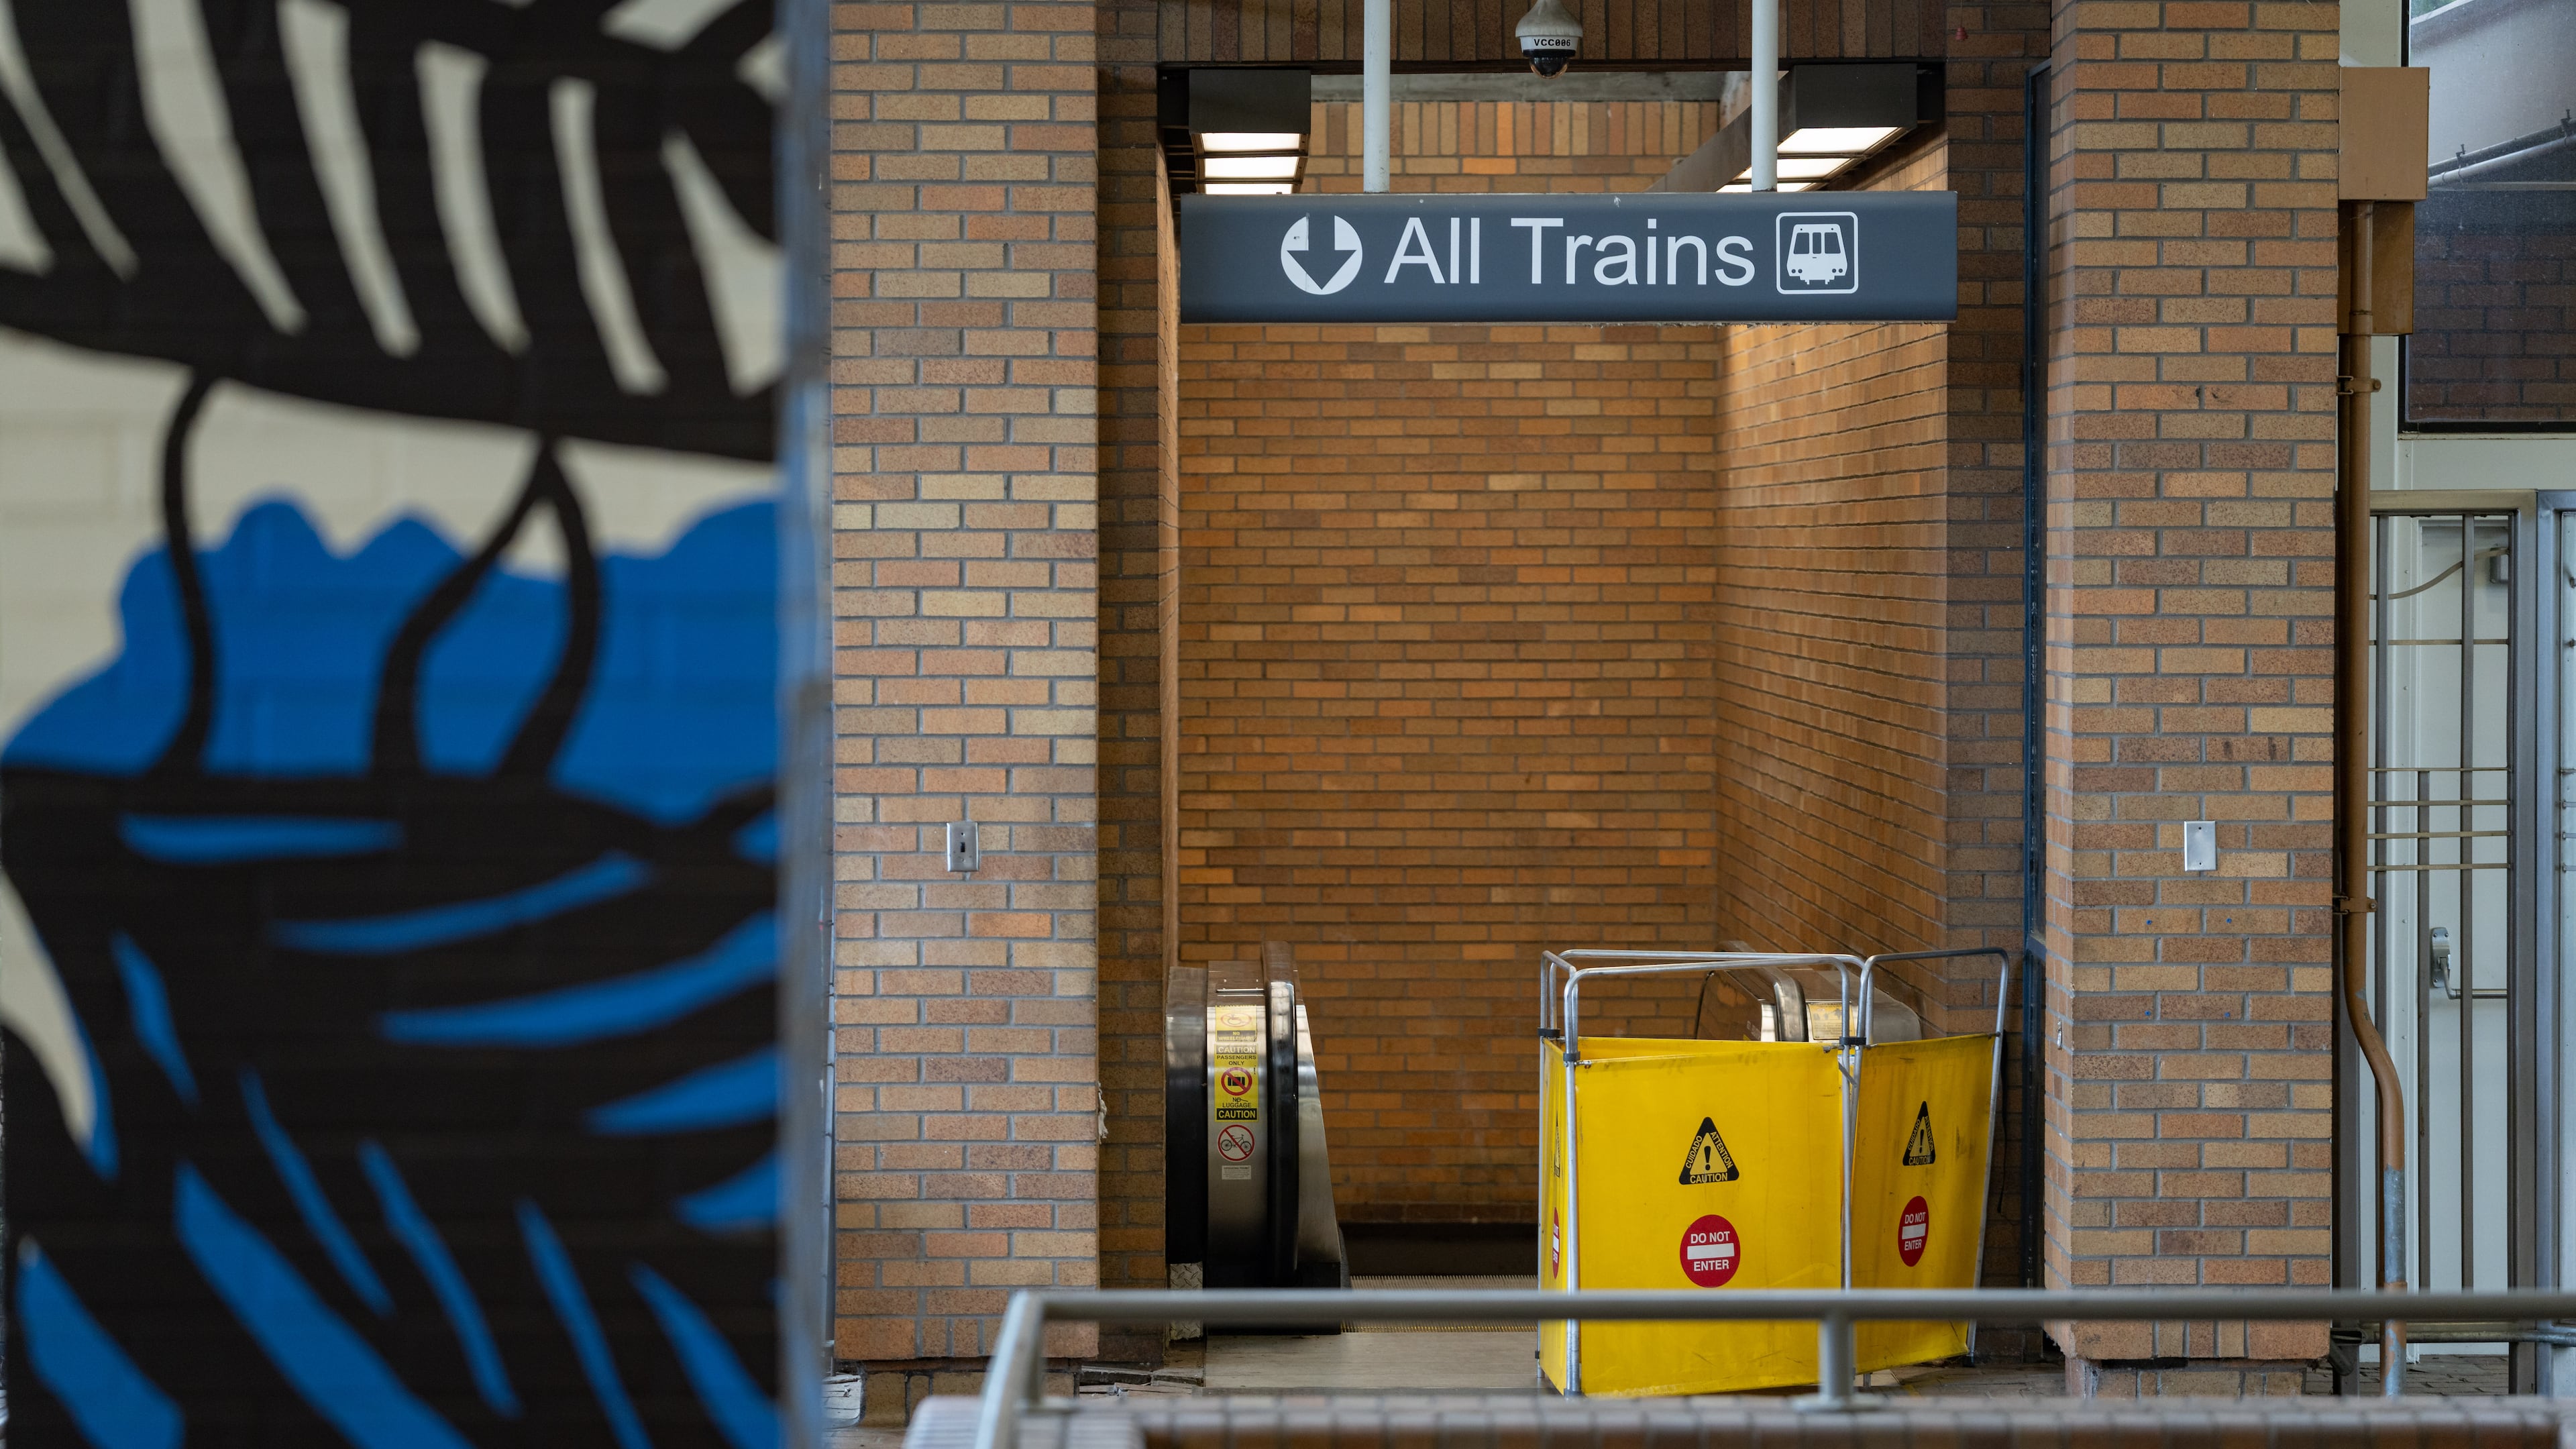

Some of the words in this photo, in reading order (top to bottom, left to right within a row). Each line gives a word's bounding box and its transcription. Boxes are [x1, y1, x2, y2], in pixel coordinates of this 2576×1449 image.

[1534, 38, 1571, 47] VCC006
[1384, 217, 1481, 284] All
[1511, 217, 1756, 286] Trains
[1218, 1110, 1256, 1118] CAUTION
[1908, 1119, 1921, 1150] CUIDADO
[1685, 1135, 1703, 1169] CUIDADO
[1710, 1131, 1733, 1169] ATTENTION
[1909, 1156, 1931, 1165] CAUTION
[1690, 1172, 1728, 1184] CAUTION
[1904, 1214, 1915, 1224] DO
[1915, 1212, 1926, 1223] NOT
[1690, 1232, 1707, 1244] DO
[1709, 1231, 1730, 1242] NOT
[1904, 1238, 1922, 1251] ENTER
[1693, 1259, 1729, 1272] ENTER
